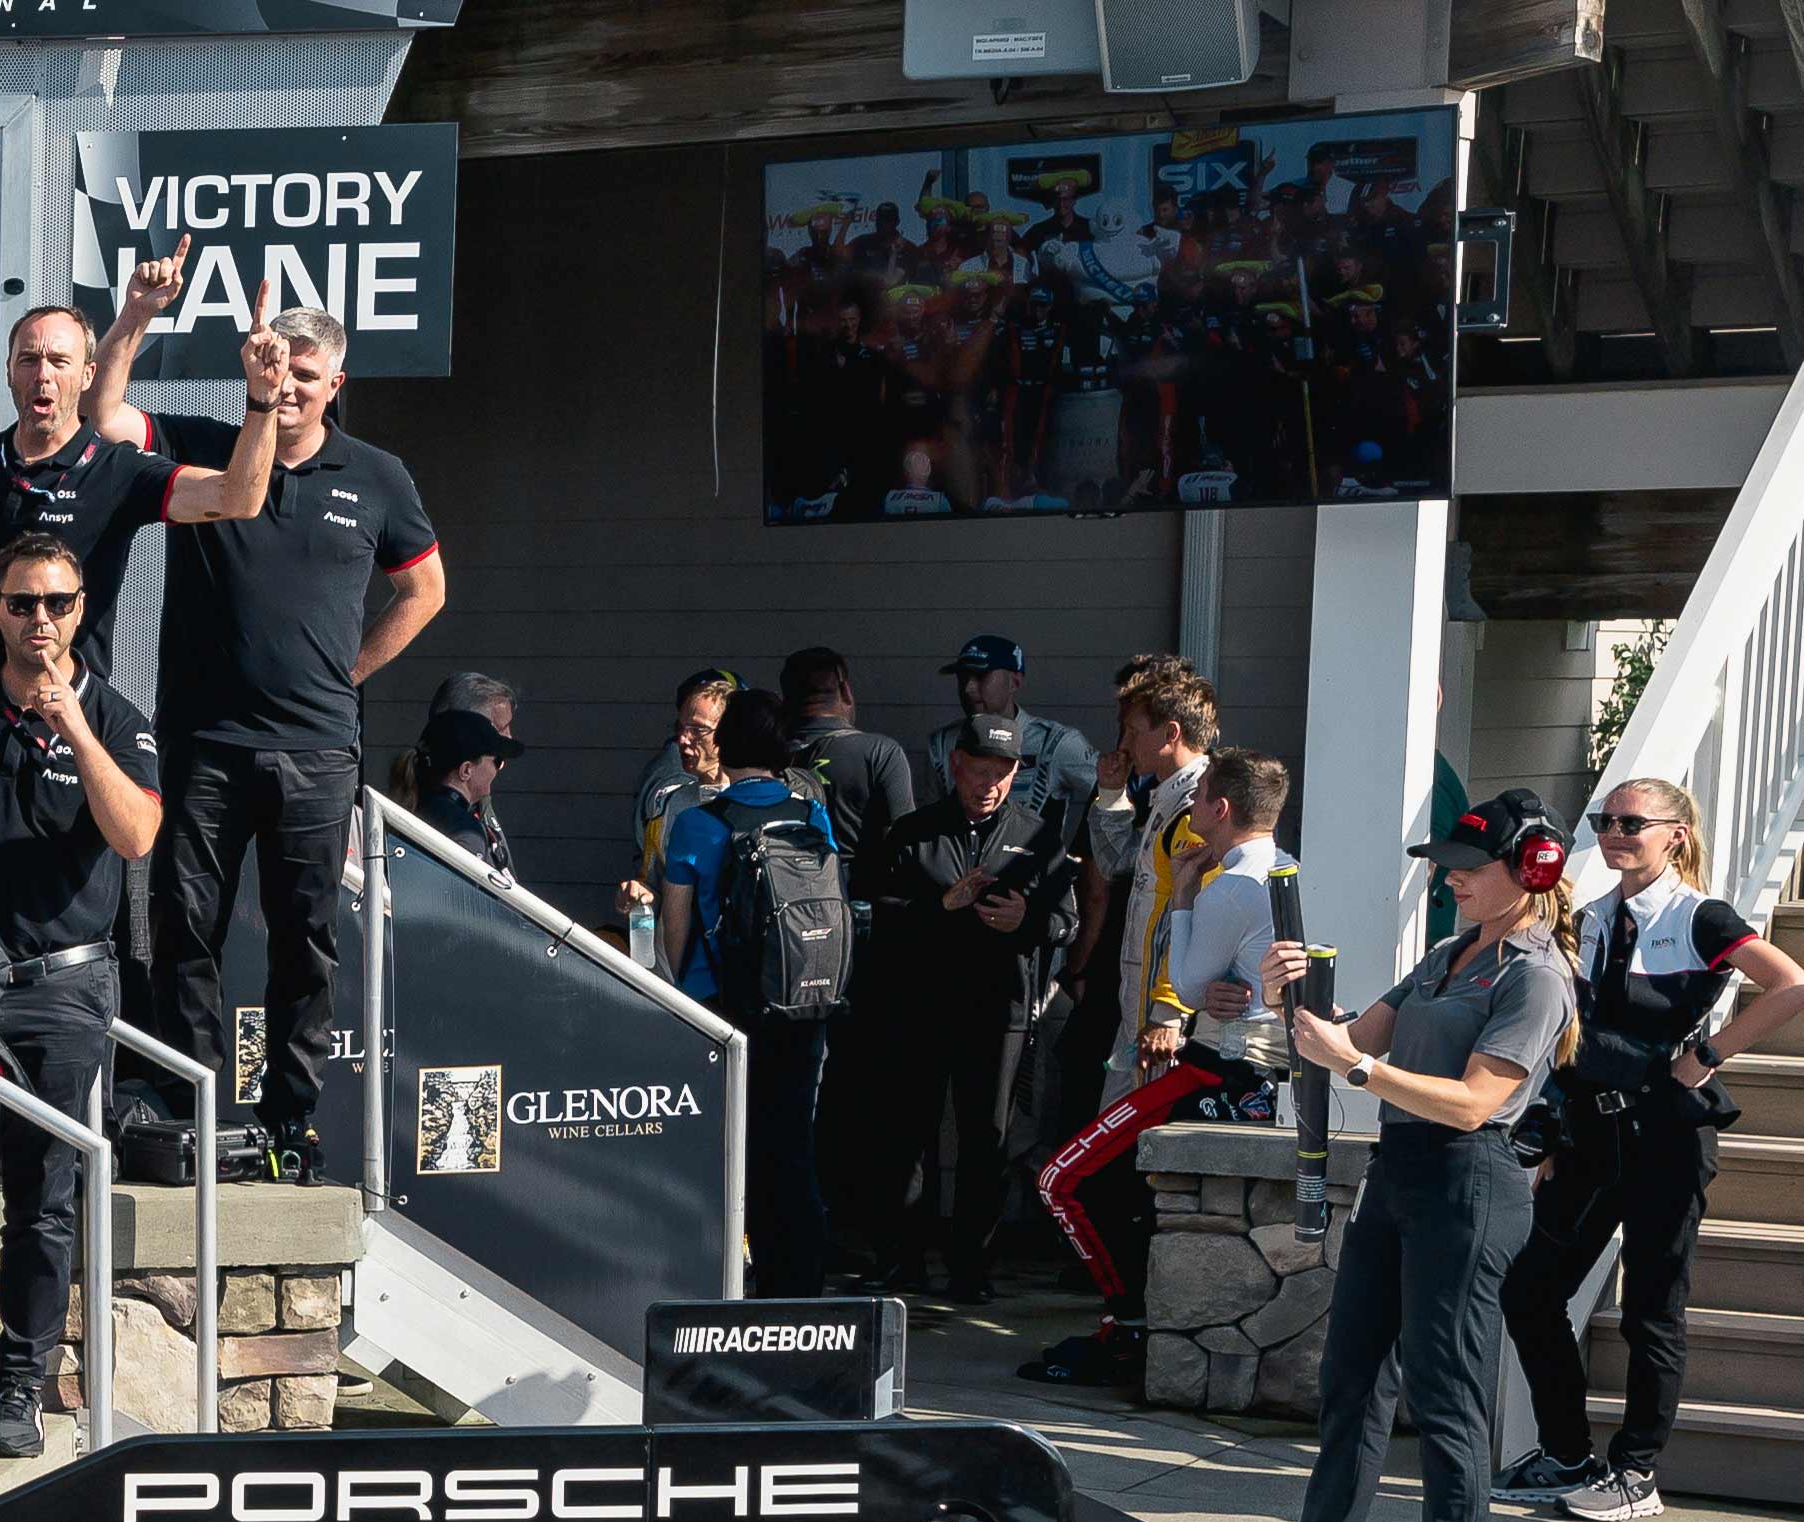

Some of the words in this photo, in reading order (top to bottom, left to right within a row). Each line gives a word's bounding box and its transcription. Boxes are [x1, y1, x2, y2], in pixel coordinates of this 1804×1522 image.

[1157, 162, 1250, 194] SIX
[115, 170, 423, 229] VICTORY
[116, 242, 420, 334] LANE
[55, 490, 77, 499] OSS
[39, 512, 74, 524] Ansys
[324, 511, 357, 527] Ansys
[43, 768, 78, 784] Ansys
[507, 1083, 702, 1126] GLENORA
[547, 1125, 590, 1139] WINE
[594, 1122, 663, 1138] CELLARS
[703, 1325, 857, 1353] RACEBORN
